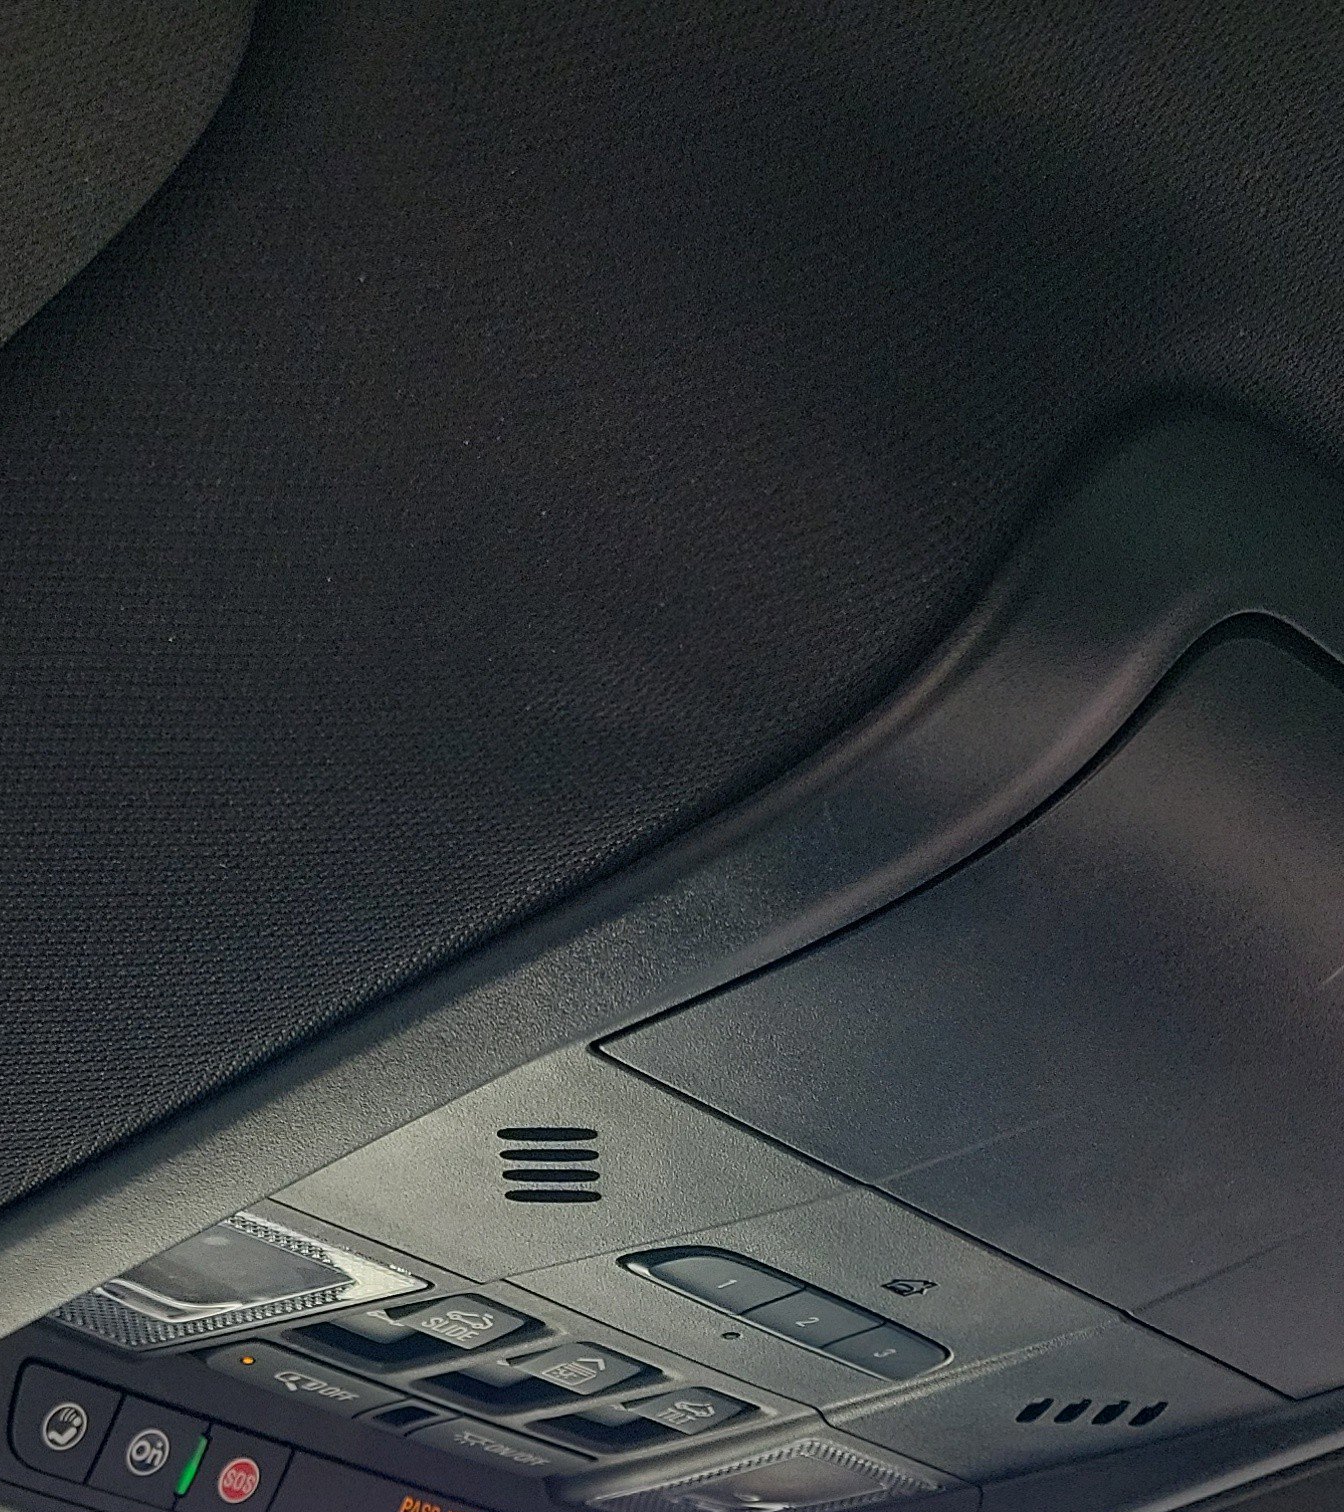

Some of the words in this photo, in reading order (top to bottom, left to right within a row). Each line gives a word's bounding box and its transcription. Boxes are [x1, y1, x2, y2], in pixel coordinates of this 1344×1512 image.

[717, 1279, 738, 1289] 1
[421, 1317, 480, 1342] SLIDE
[795, 1316, 820, 1328] 2
[873, 1347, 897, 1358] 3
[318, 1386, 359, 1401] OFF
[657, 1407, 696, 1425] TILT
[222, 1469, 256, 1495] SOS
